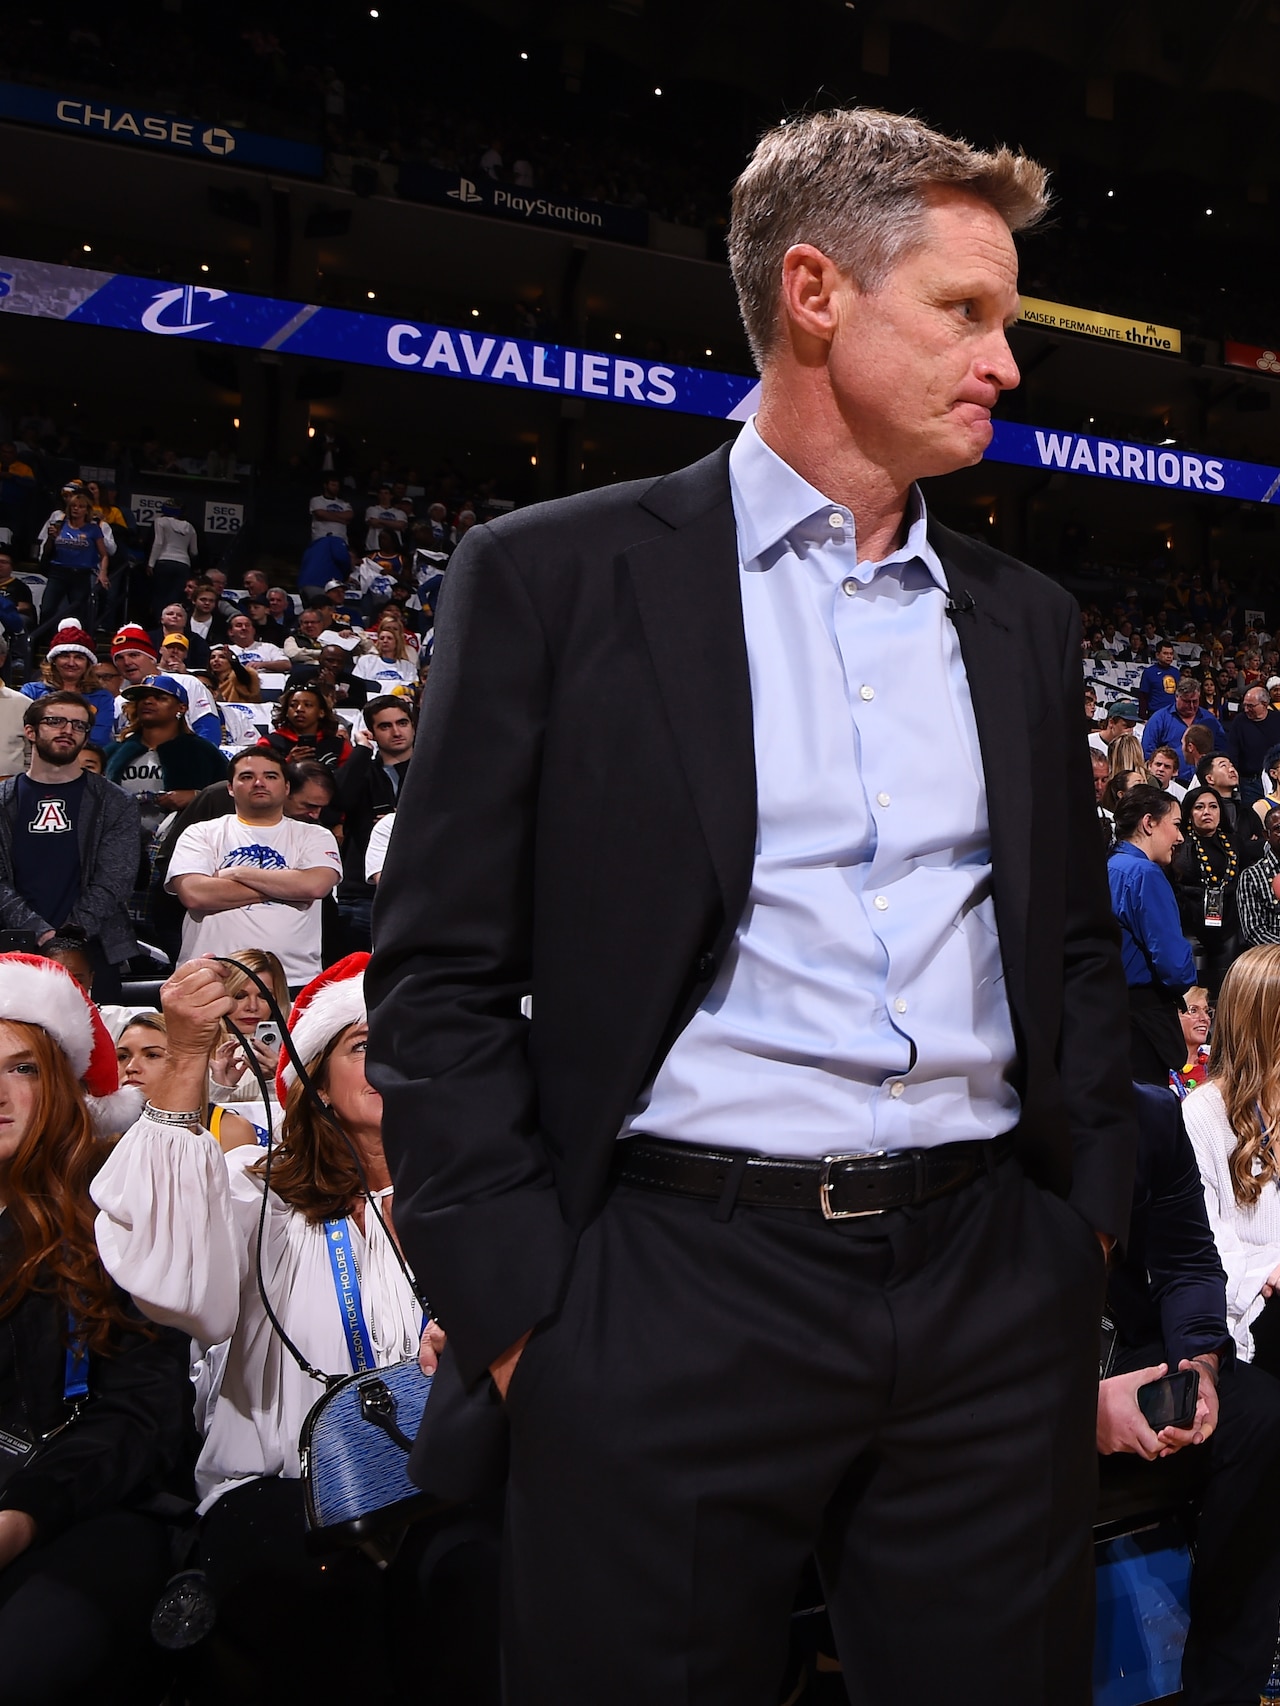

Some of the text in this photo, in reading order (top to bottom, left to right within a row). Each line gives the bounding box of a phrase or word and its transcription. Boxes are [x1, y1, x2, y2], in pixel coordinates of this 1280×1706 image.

[56, 100, 195, 146] CHASE
[493, 189, 603, 227] PlayStation
[1024, 310, 1056, 326] KAISER
[1125, 326, 1171, 349] thrive
[386, 324, 676, 404] CAVALIERS
[1034, 430, 1225, 492] WARRIORS
[140, 499, 163, 509] SEC
[213, 506, 236, 516] SEC
[207, 516, 240, 532] 128
[121, 765, 163, 781] OOK
[28, 799, 72, 833] A
[335, 1246, 368, 1372] SEASON TICKET HOLDER
